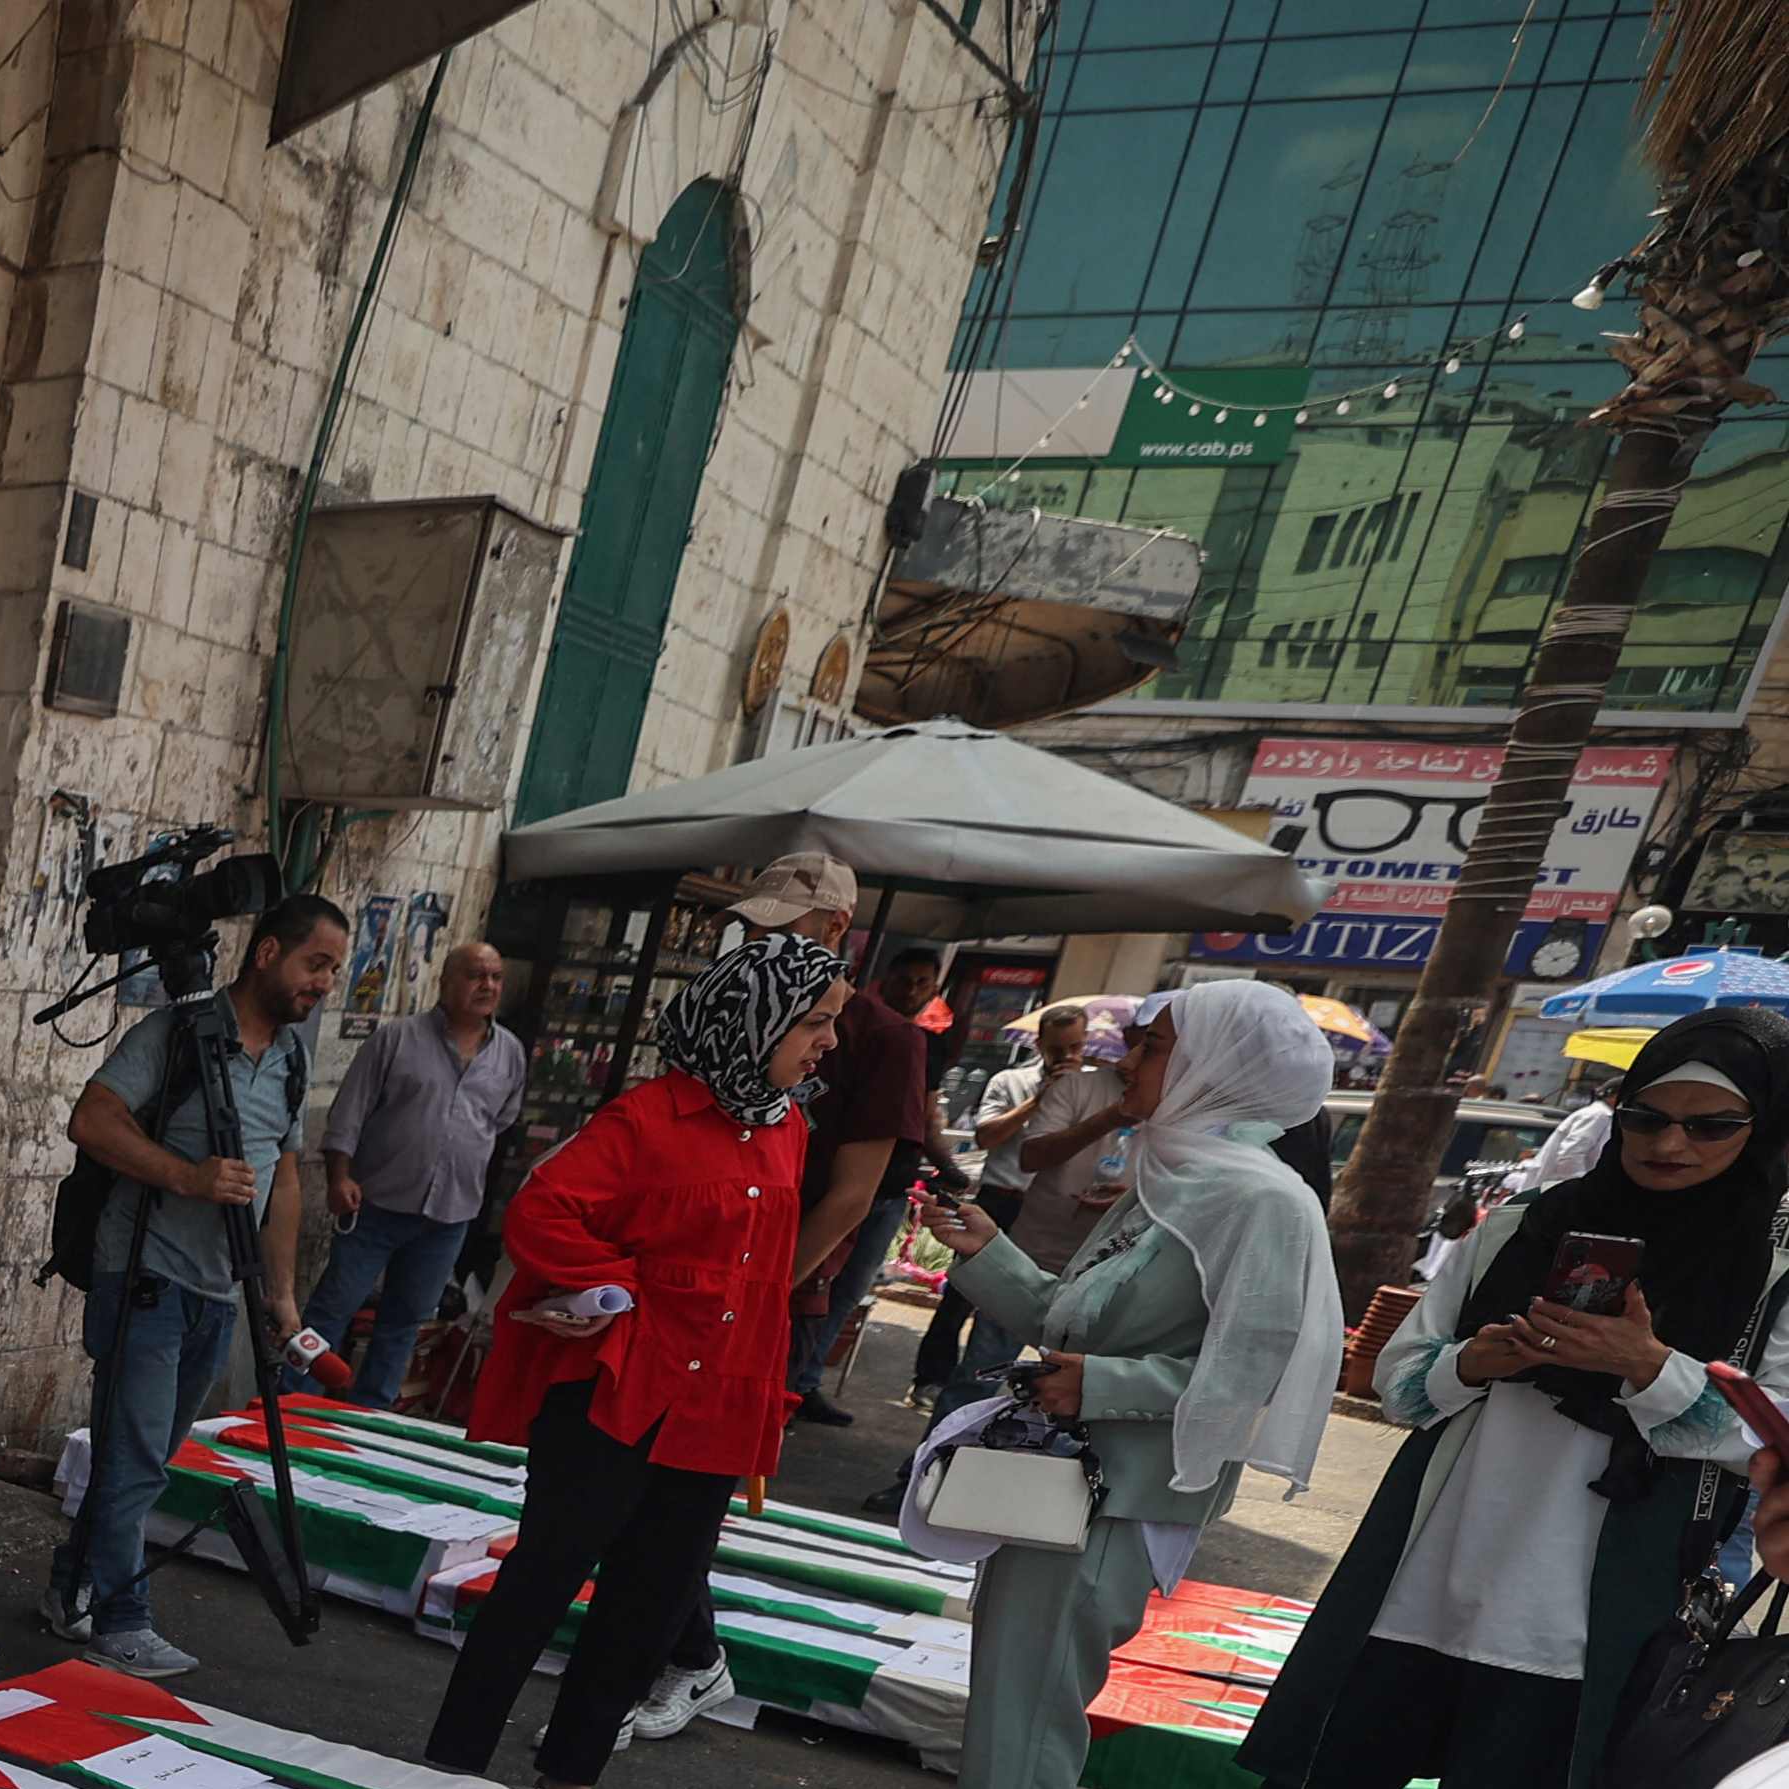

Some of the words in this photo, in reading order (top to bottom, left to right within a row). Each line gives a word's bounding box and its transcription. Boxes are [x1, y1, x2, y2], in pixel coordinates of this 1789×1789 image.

[1139, 440, 1254, 458] www.cab.ps
[1375, 750, 1464, 776] تفاحة
[1575, 752, 1659, 781] شمس
[1571, 806, 1642, 836] طارق
